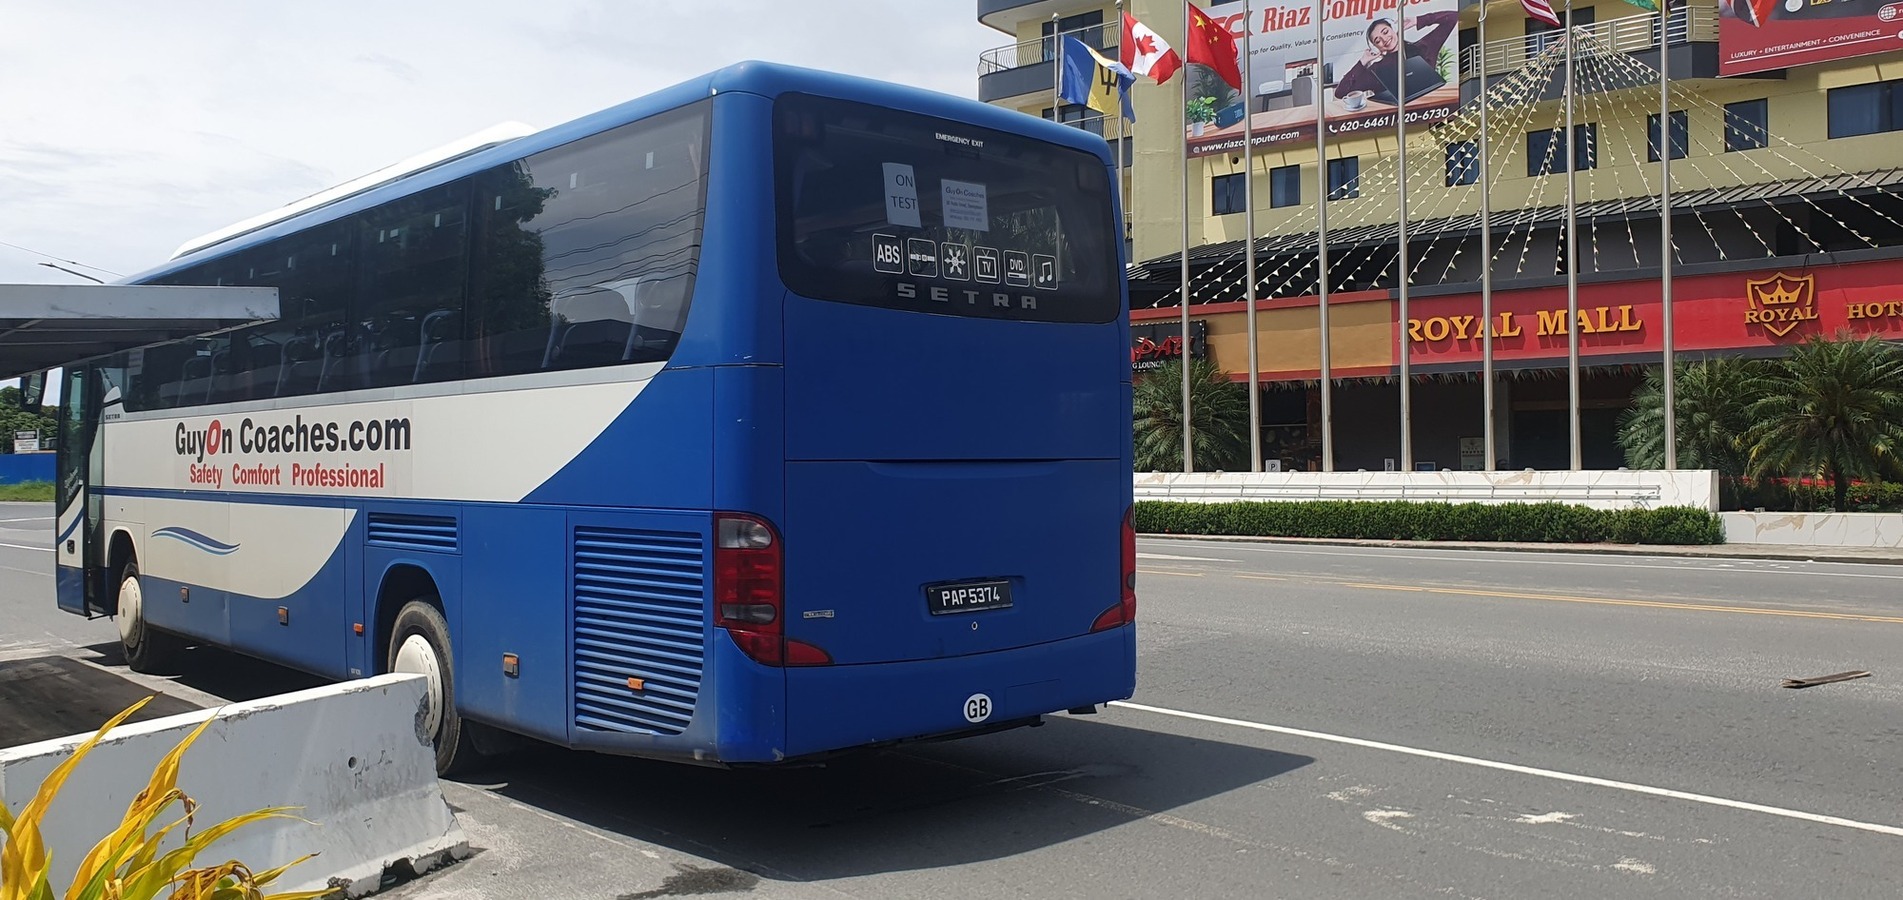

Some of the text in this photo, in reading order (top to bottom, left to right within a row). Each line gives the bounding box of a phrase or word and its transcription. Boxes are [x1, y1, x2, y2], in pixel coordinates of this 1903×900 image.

[1261, 6, 1311, 33] Riaz
[1320, 0, 1430, 21] ompu
[1260, 45, 1268, 53] for
[1270, 43, 1293, 53] Quality,
[1295, 39, 1310, 47] Value
[1326, 30, 1364, 42] Consistency
[1730, 29, 1880, 59] LUXURY ENTERTAINMENT CONVENIENCE
[1340, 115, 1389, 132] 620-6461
[1397, 107, 1449, 123] 20-6730
[935, 132, 984, 148] EMERGENCY EXIT
[1201, 130, 1300, 152] www.riazcmputer.com
[895, 174, 913, 188] ON
[891, 195, 917, 210] TEST
[877, 244, 900, 265] ABS
[1010, 258, 1023, 271] DVD
[982, 260, 991, 273] TV
[897, 283, 1037, 310] SETRA
[1744, 306, 1818, 324] ROYAL
[1848, 301, 1903, 319] HOT
[1398, 304, 1643, 342] ROYAL MALL
[175, 414, 411, 463] GuyOn Coaches.com
[190, 462, 384, 489] Safety Comfort Professional
[967, 698, 988, 719] GB
